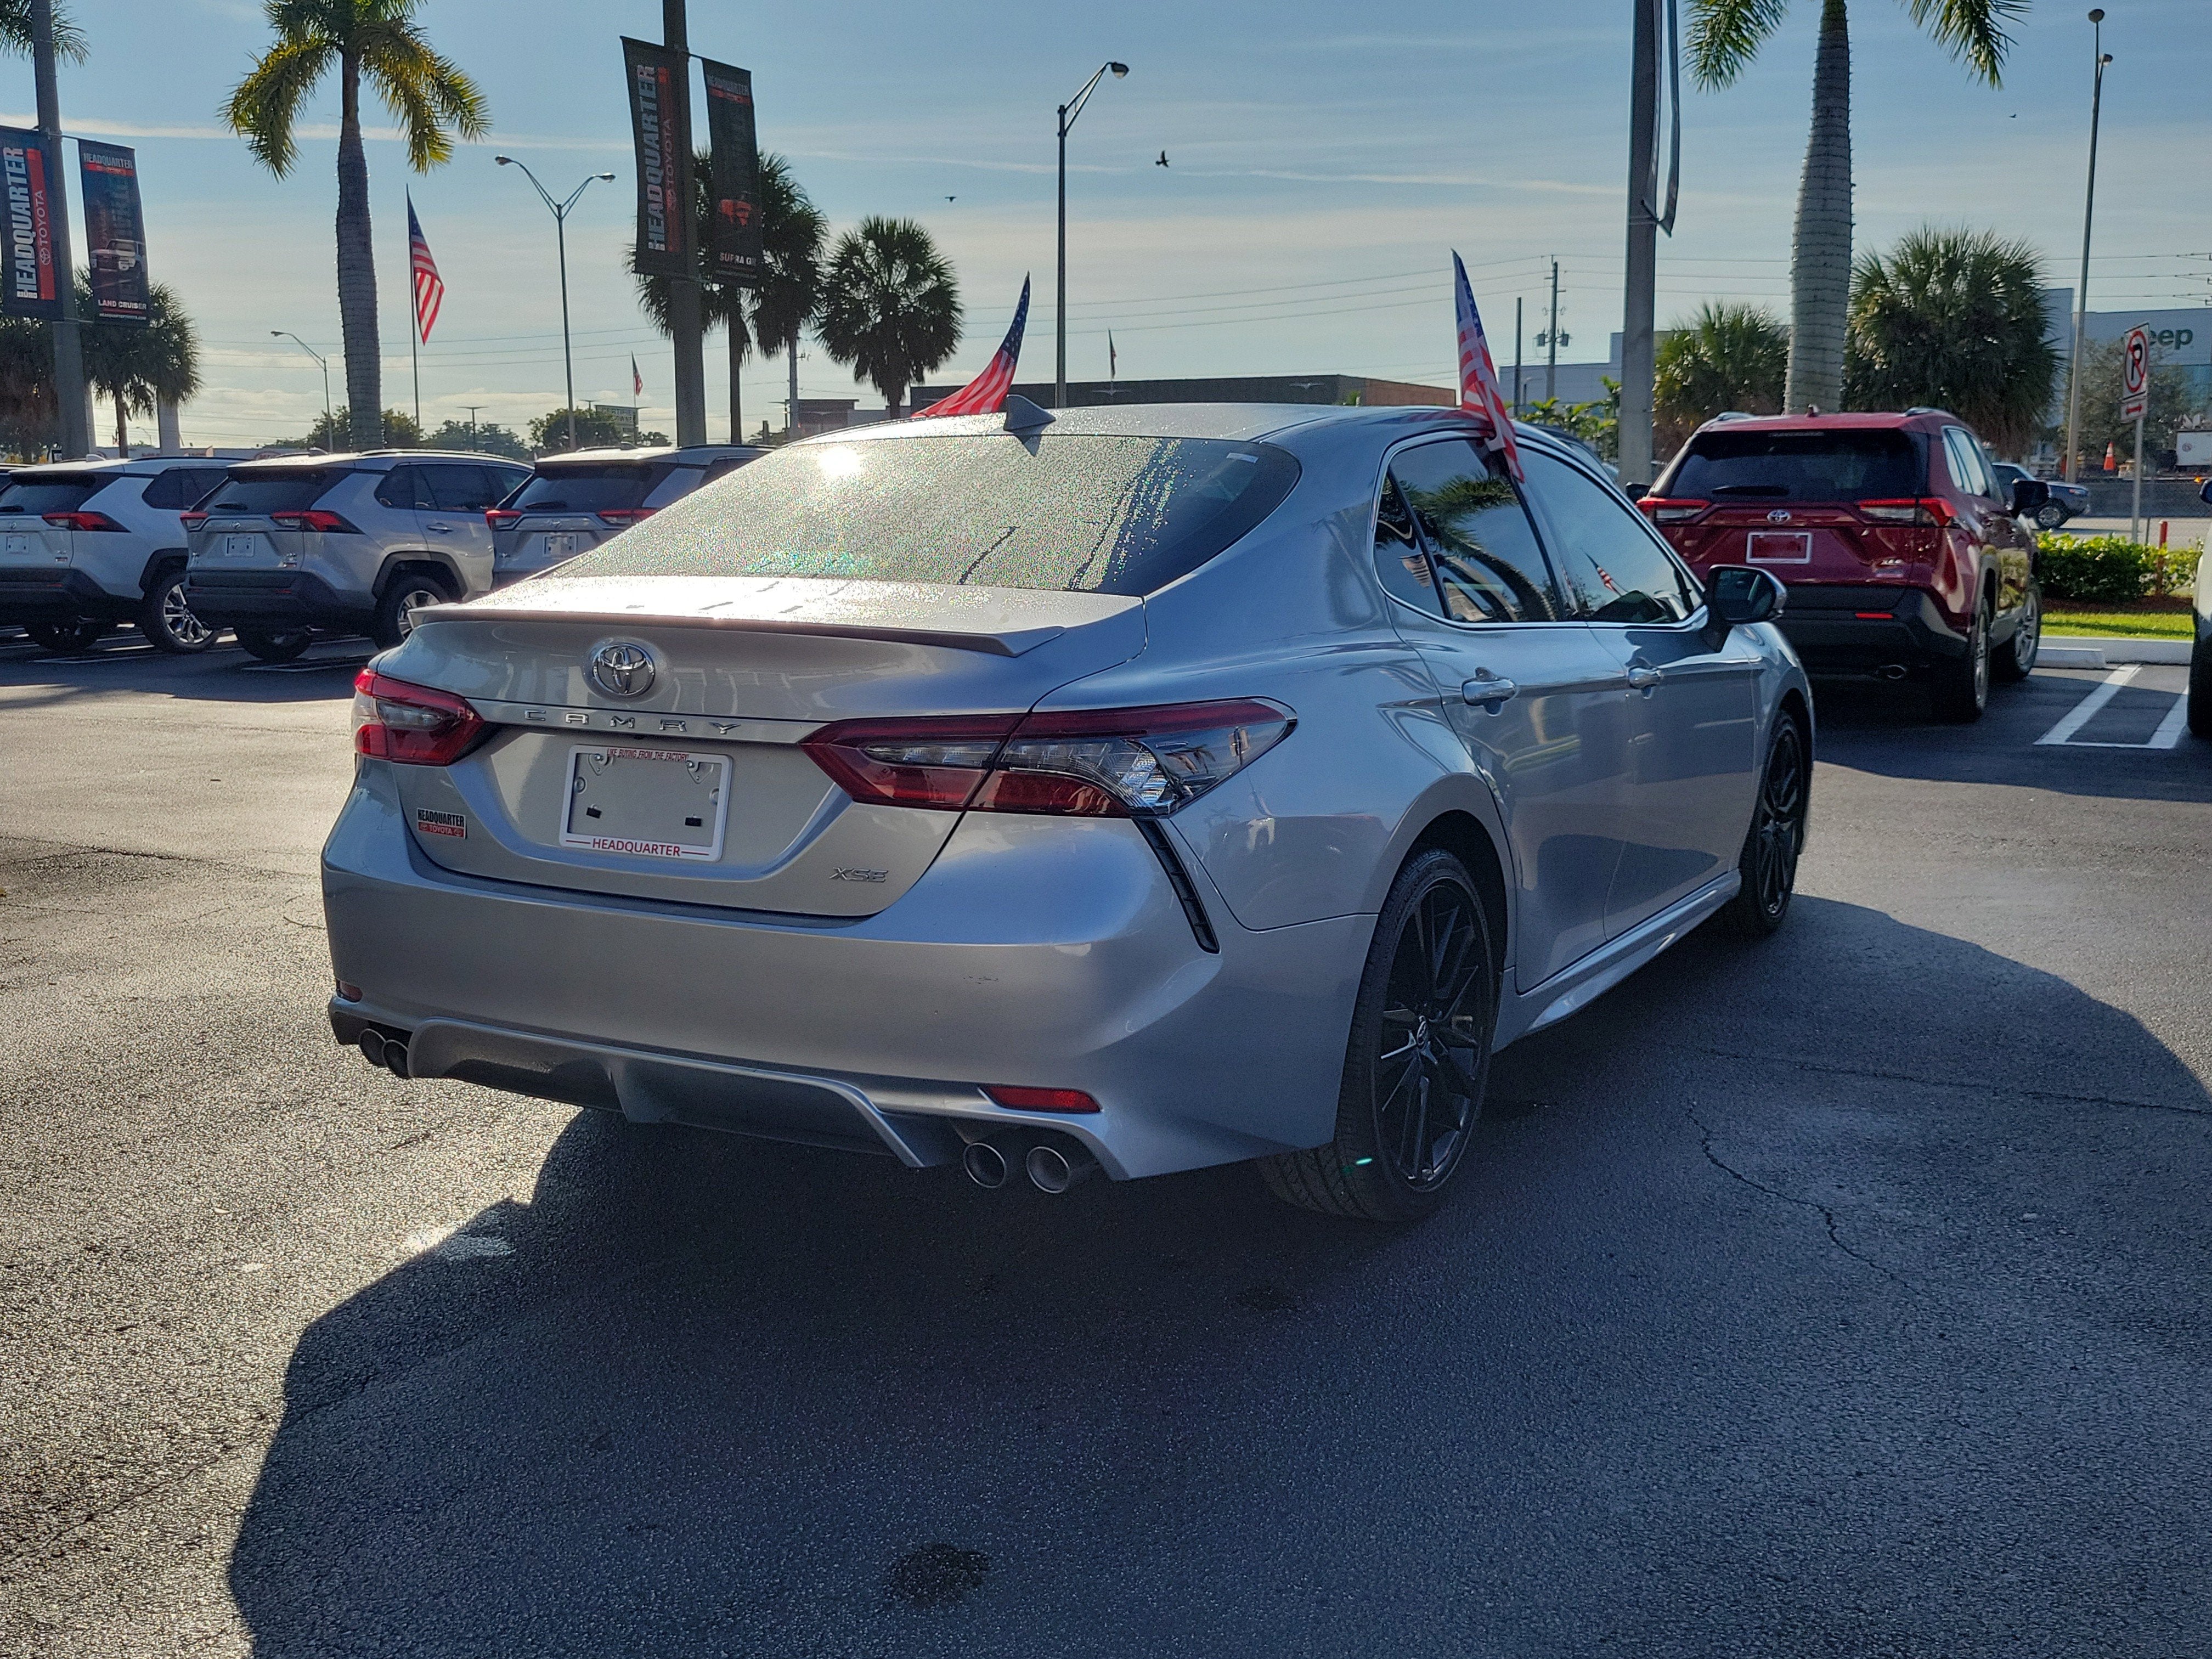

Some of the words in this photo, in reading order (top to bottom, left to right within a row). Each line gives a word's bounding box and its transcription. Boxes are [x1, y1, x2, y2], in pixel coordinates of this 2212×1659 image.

[83, 153, 133, 169] HEADQUARTER
[636, 64, 665, 251] HEADQUARTER
[661, 119, 675, 187] TOYOTA
[3, 146, 38, 300] HEADQUARTER
[34, 190, 48, 245] TOYOTA
[118, 301, 146, 309] CRUISER
[524, 708, 742, 735] CAMRY
[607, 748, 618, 756] LIKE
[618, 749, 637, 758] BUYING
[639, 750, 653, 759] FROM
[654, 751, 664, 760] THE
[417, 809, 465, 827] HEADQUARTER
[429, 824, 453, 835] TOYOTA
[592, 838, 681, 856] HEADQUARTER
[829, 867, 889, 883] XSE
